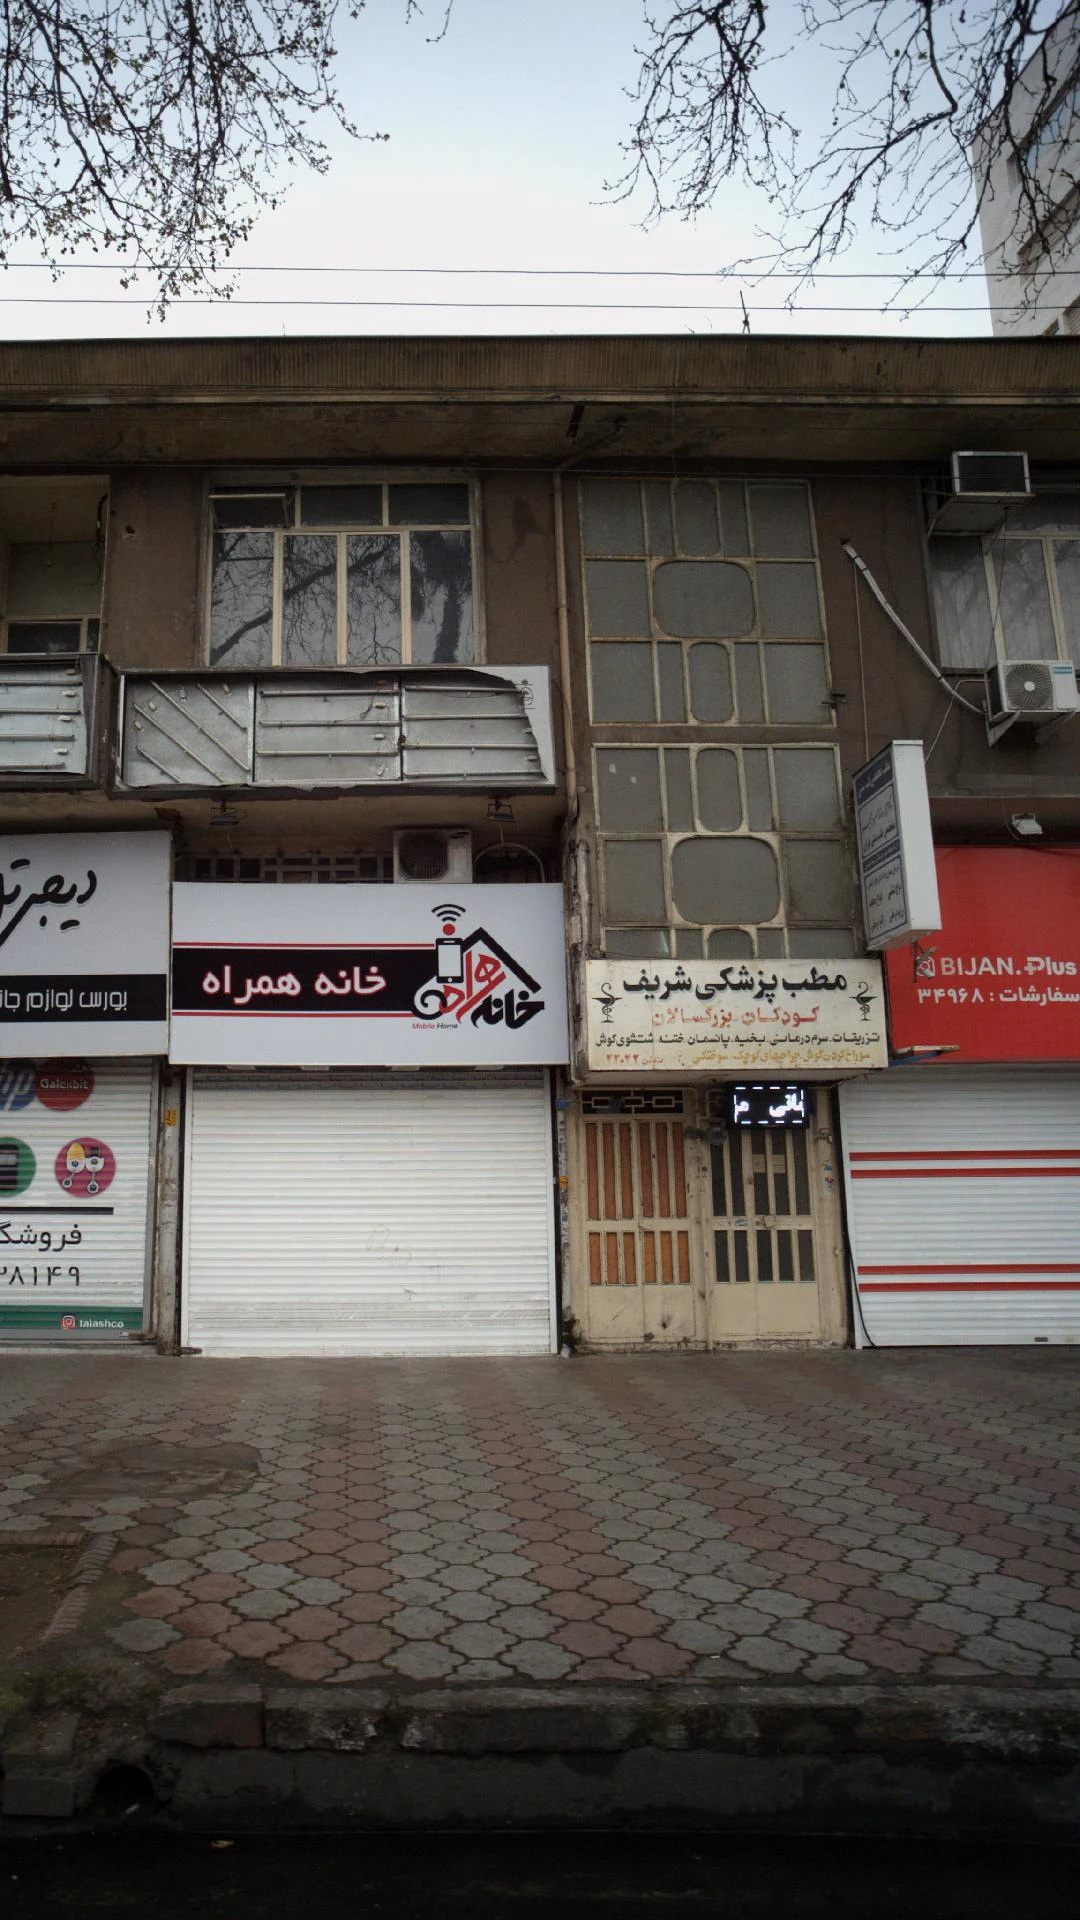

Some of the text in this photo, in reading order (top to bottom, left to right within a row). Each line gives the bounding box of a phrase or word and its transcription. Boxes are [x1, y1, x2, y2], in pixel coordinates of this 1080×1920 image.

[202, 965, 388, 1005] خانه همراه
[622, 965, 848, 1004] مطب پزشکی شریف
[26, 989, 74, 1012] لوازم
[79, 990, 128, 1012] بورس
[999, 985, 1080, 1007] سفارشات
[411, 1022, 459, 1031] Mobile Home
[79, 1318, 125, 1330] talashco
